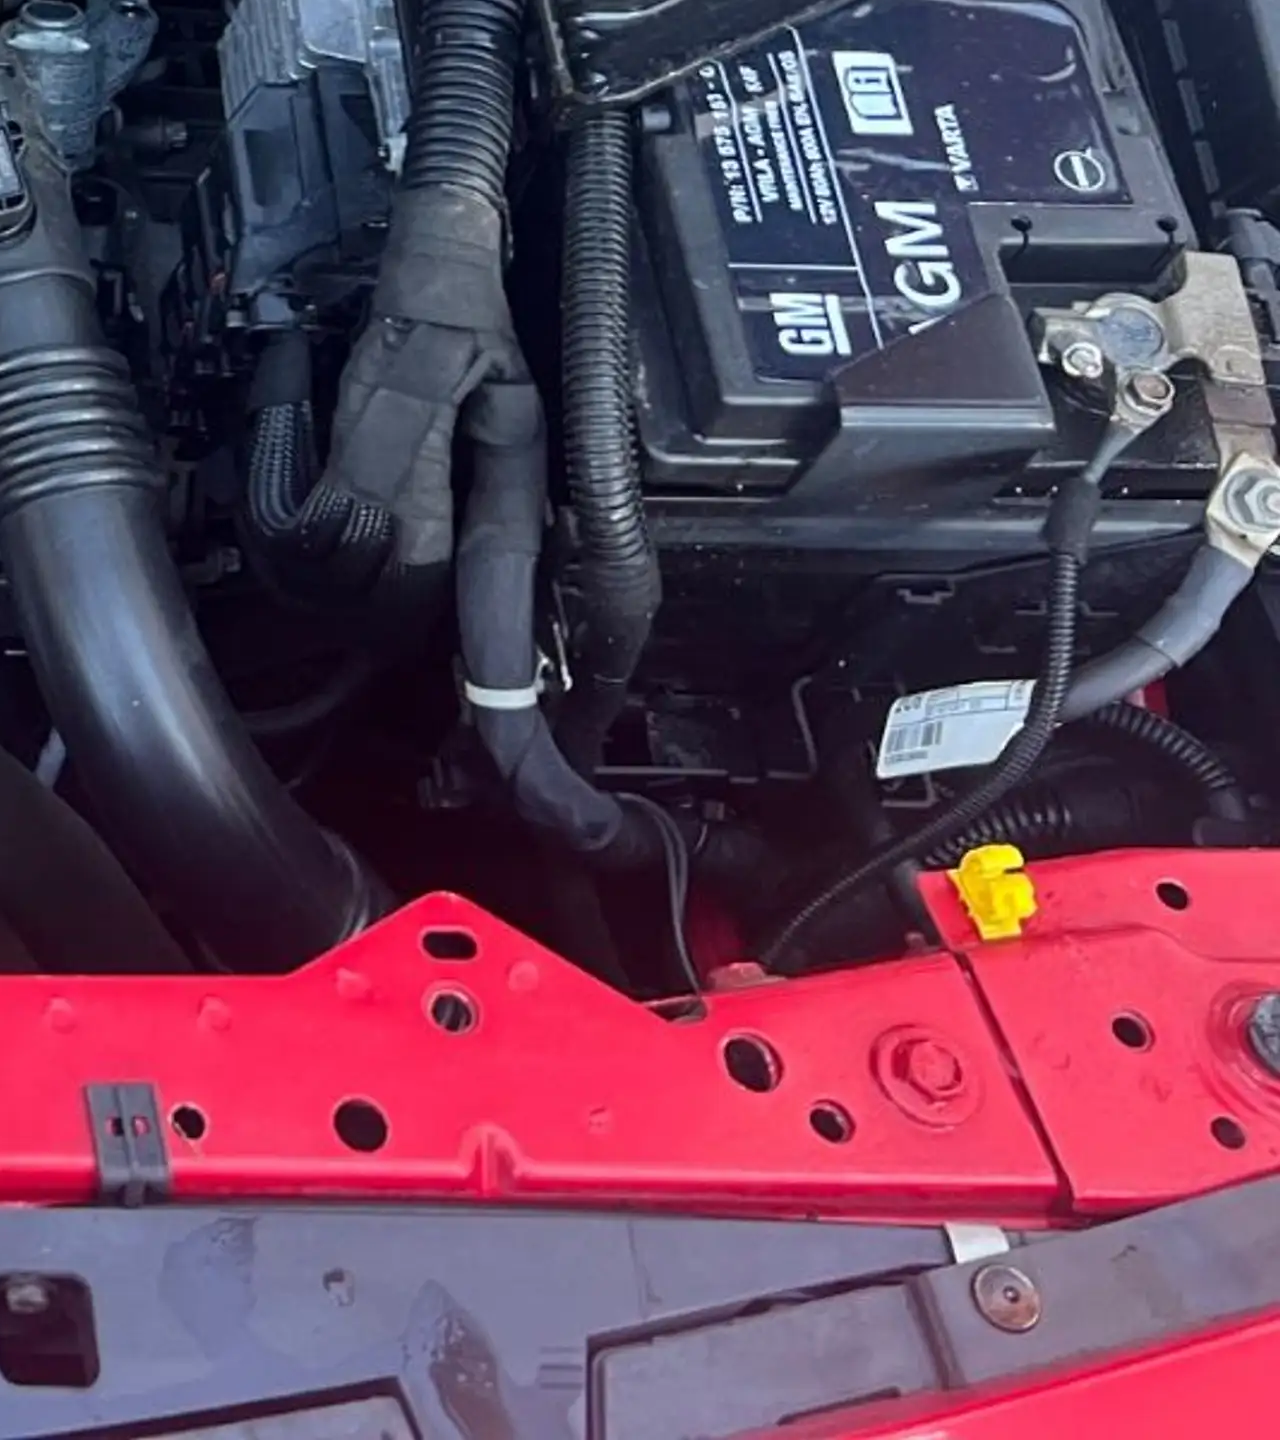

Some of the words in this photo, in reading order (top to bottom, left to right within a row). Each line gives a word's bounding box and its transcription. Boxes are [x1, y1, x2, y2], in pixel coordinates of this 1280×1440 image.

[934, 103, 972, 174] VARTA
[874, 201, 962, 308] GM
[769, 292, 836, 355] GM
